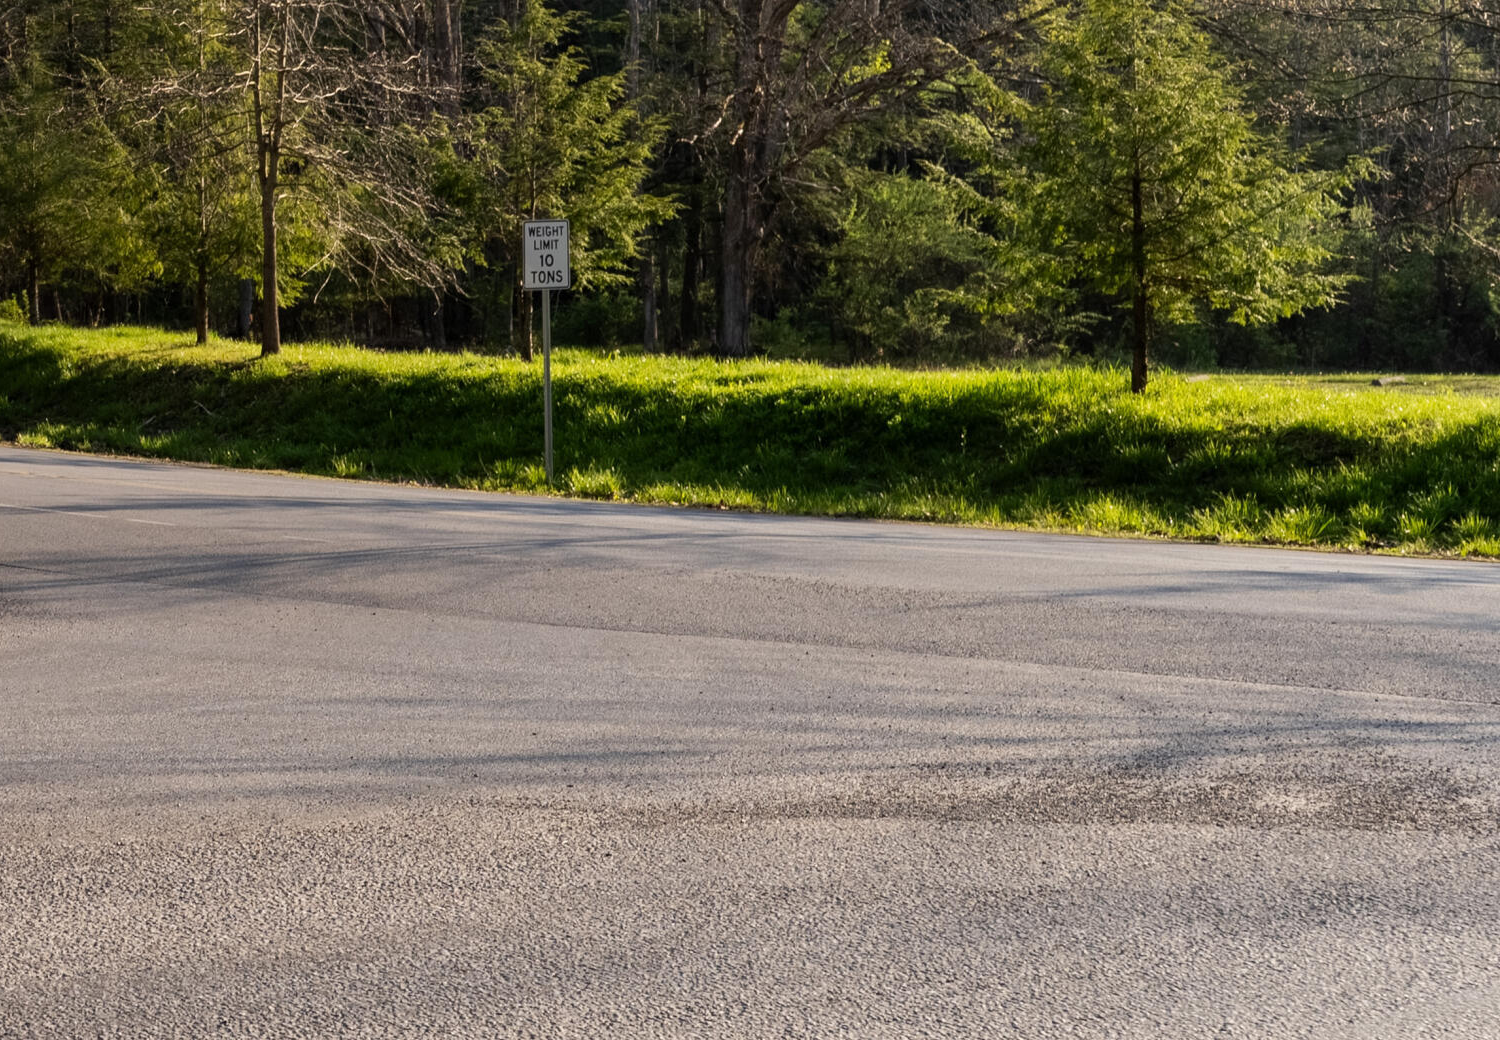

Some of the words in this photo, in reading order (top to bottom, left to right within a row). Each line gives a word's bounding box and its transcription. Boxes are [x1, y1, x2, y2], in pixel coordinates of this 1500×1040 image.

[528, 226, 564, 237] WEIGHT
[534, 240, 559, 250] LIMIT
[540, 254, 554, 267] 10
[531, 270, 563, 284] TONS
